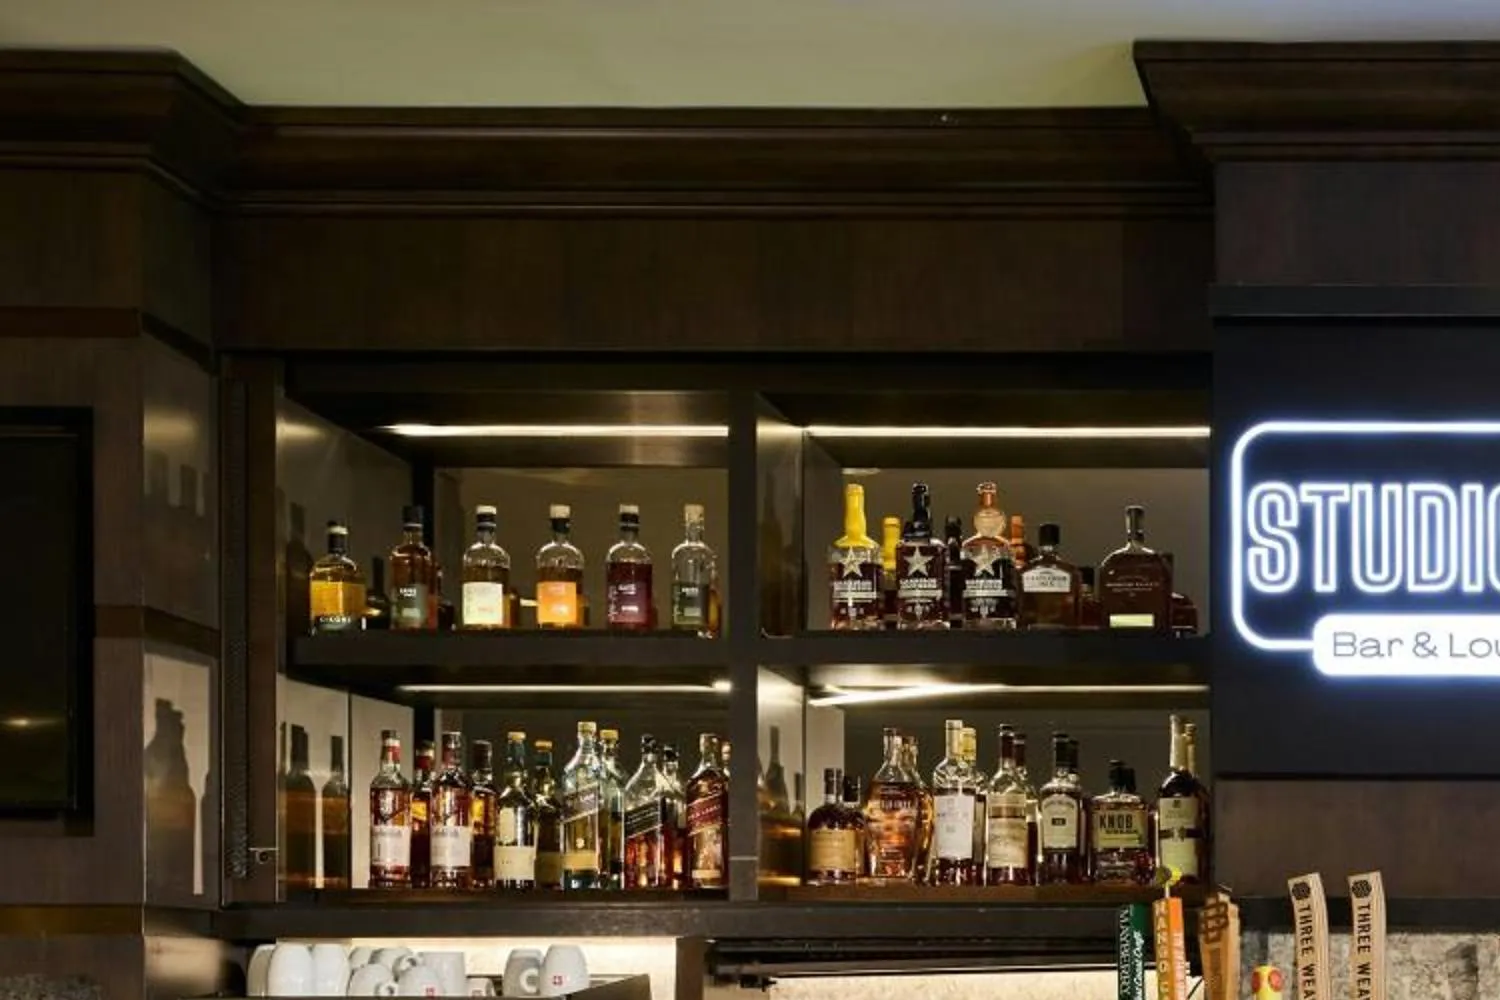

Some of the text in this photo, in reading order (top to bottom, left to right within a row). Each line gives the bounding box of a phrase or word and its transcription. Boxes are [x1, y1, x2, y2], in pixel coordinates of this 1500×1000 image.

[1332, 631, 1403, 659] Bar
[1412, 631, 1438, 659] &
[1119, 909, 1131, 995] MAYBERRY
[1298, 903, 1313, 956] THREE
[1357, 903, 1371, 954] THREE
